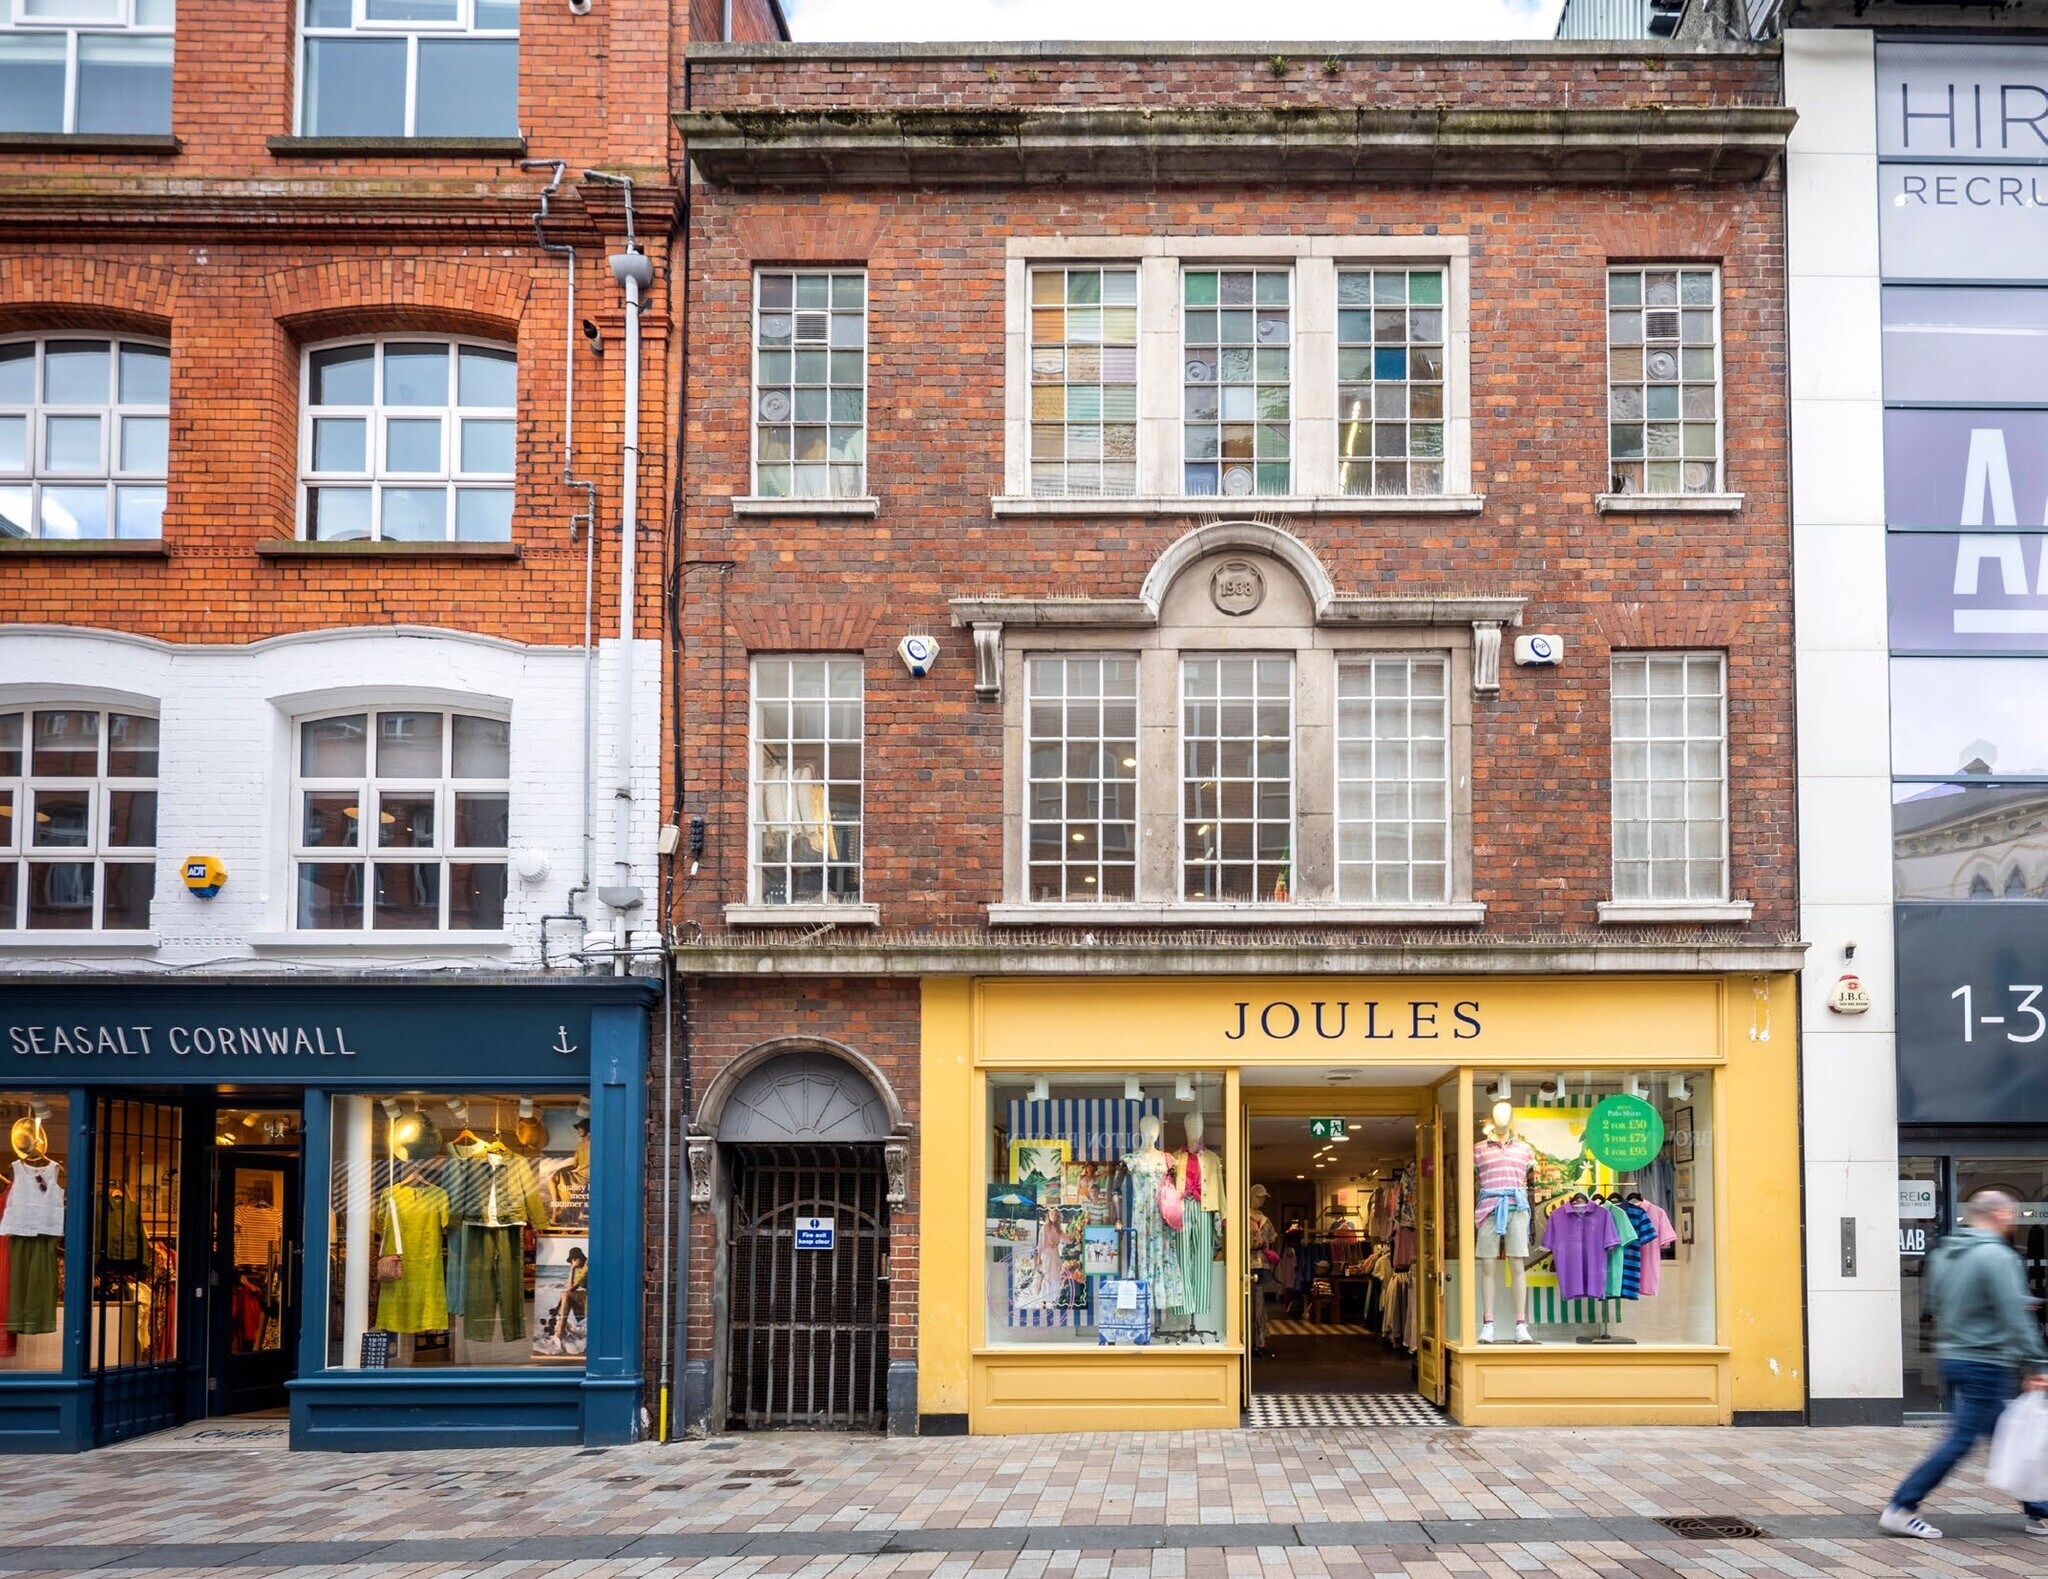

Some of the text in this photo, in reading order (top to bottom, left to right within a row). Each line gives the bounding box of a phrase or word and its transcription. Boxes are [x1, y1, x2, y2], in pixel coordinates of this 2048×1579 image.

[1902, 83, 2048, 148] HIR
[1903, 176, 2048, 206] RECRU
[1953, 428, 2048, 595] A
[1220, 581, 1254, 597] 1938
[188, 866, 206, 876] ADT
[1839, 992, 1869, 1001] J.B.C.
[1225, 1001, 1481, 1039] JOULES
[1951, 985, 2046, 1043] 1-3
[9, 1026, 356, 1055] SEASALT CORNWALL
[1603, 1120, 1609, 1129] 2
[1629, 1120, 1647, 1129] £50
[1629, 1133, 1647, 1142] £75
[1629, 1147, 1647, 1156] £95
[558, 1184, 586, 1193] Quality
[1899, 1191, 1931, 1201] REIQ
